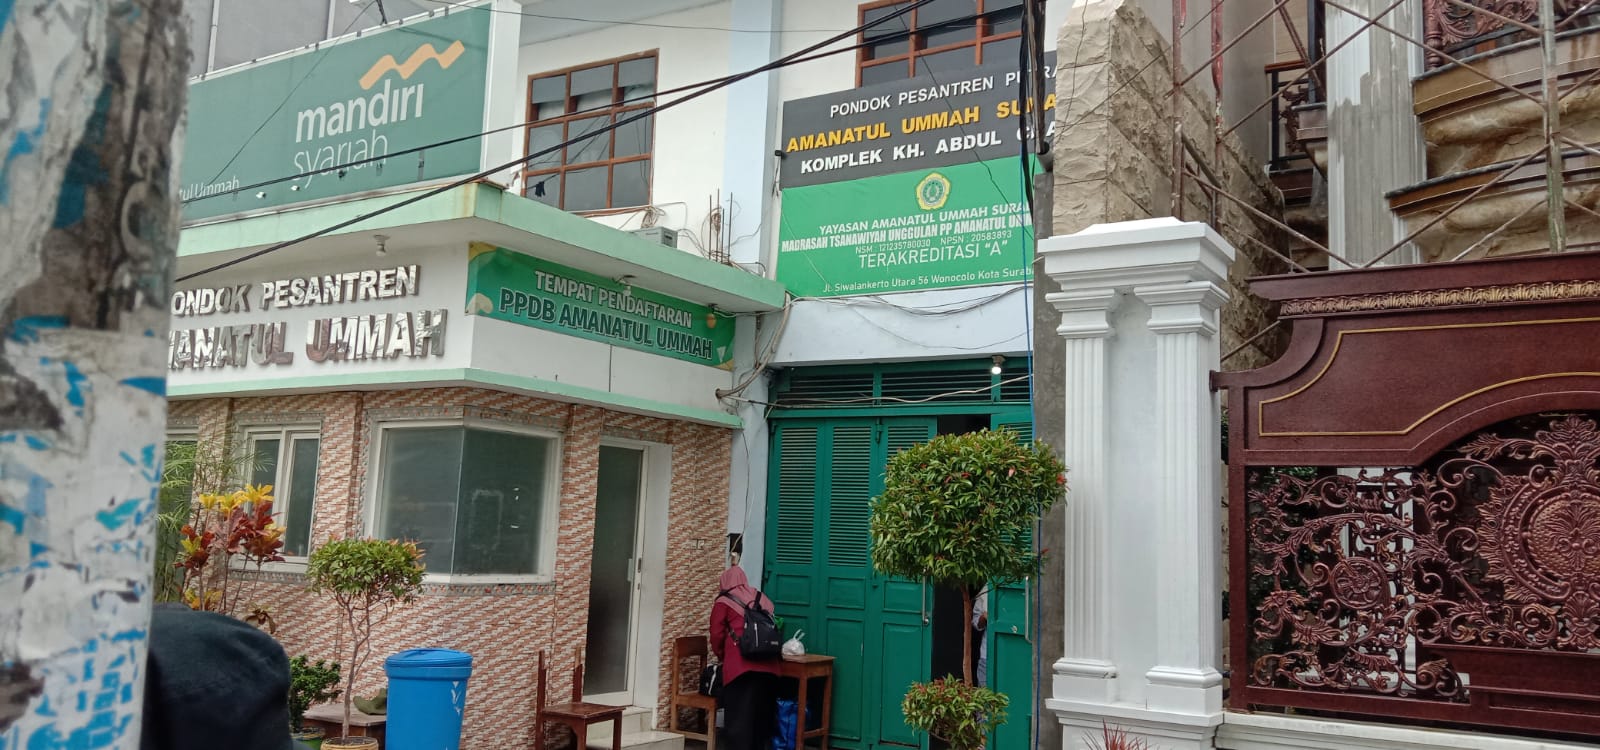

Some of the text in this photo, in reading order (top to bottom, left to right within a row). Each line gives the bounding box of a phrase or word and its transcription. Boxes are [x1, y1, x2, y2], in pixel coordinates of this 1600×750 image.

[295, 79, 424, 143] mandiri
[830, 94, 891, 118] PONDOK
[898, 75, 994, 106] PESANTREN
[786, 121, 891, 153] AMANATUL
[901, 105, 980, 135] UMMAH
[293, 129, 389, 190] syariah
[800, 148, 882, 174] KOMPLEK
[893, 143, 925, 161] KH.
[935, 130, 1002, 155] ABDUL
[195, 175, 240, 199] Ummah
[781, 235, 828, 253] MADRASAH
[829, 229, 887, 248] TSANAWIYAH
[888, 223, 938, 242] UNGGULAN
[939, 221, 953, 236] PP
[953, 215, 1006, 235] AMANATUL
[819, 221, 868, 235] YAYASAN
[871, 213, 936, 229] AMANATUL
[938, 206, 989, 222] UMMAH
[855, 229, 1012, 255] NSM 121235780030 NPSN 20583893
[858, 243, 980, 269] TERAKREDITASI
[261, 264, 420, 310] PESANTREN
[535, 270, 693, 329] TEMPAT PENDAFTARAN
[834, 279, 890, 292] Siwalankerto
[892, 276, 916, 287] Utara
[918, 274, 929, 284] 56
[931, 272, 976, 284] Wonocolo
[978, 269, 1000, 279] Kota
[305, 308, 448, 364] UMMAH
[500, 288, 713, 361] PPDB AMANATUL UMMAH
